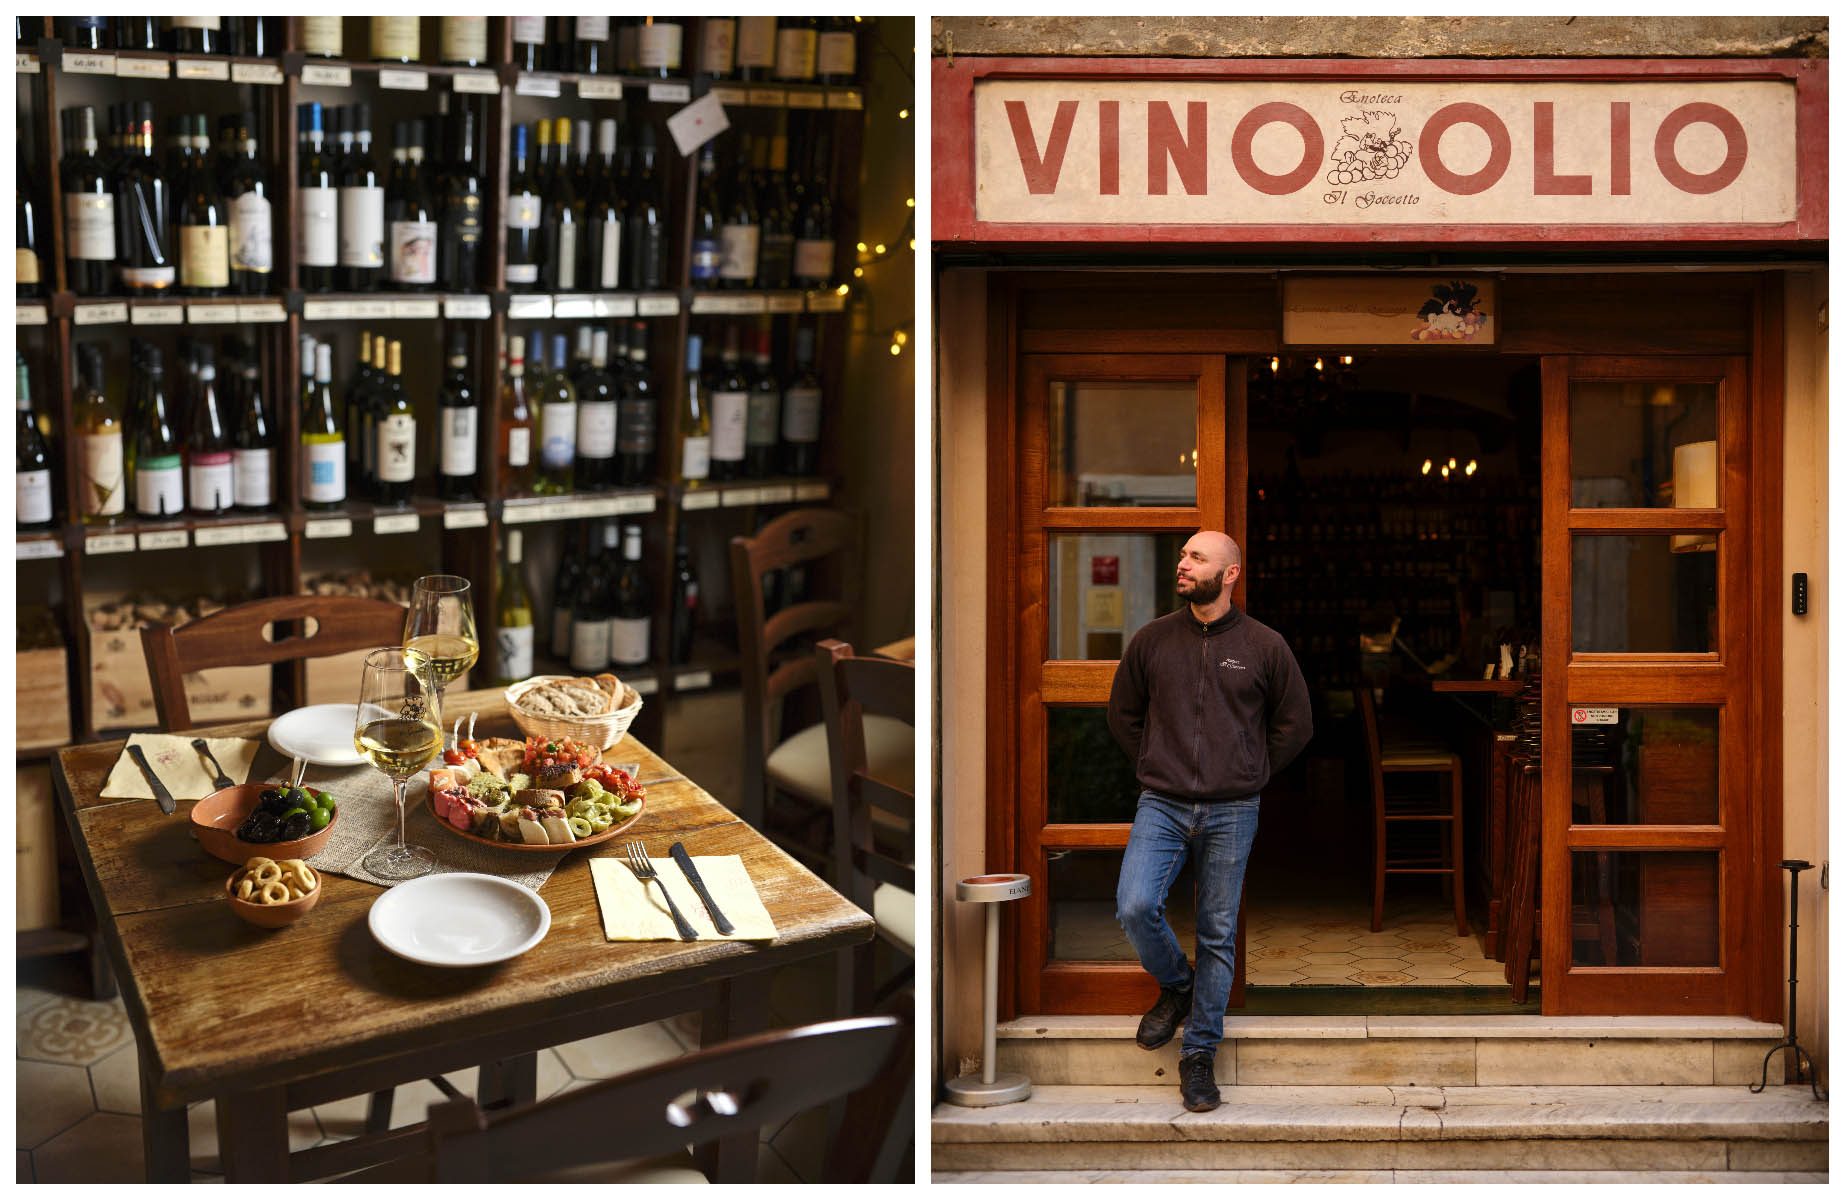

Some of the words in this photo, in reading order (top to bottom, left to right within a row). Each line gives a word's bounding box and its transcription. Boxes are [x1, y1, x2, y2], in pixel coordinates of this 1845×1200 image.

[1339, 90, 1403, 104] Enoteca
[1004, 100, 1324, 195] VINO
[1418, 101, 1748, 195] OLIO
[1323, 190, 1348, 205] Il
[1355, 190, 1420, 209] Goccetto
